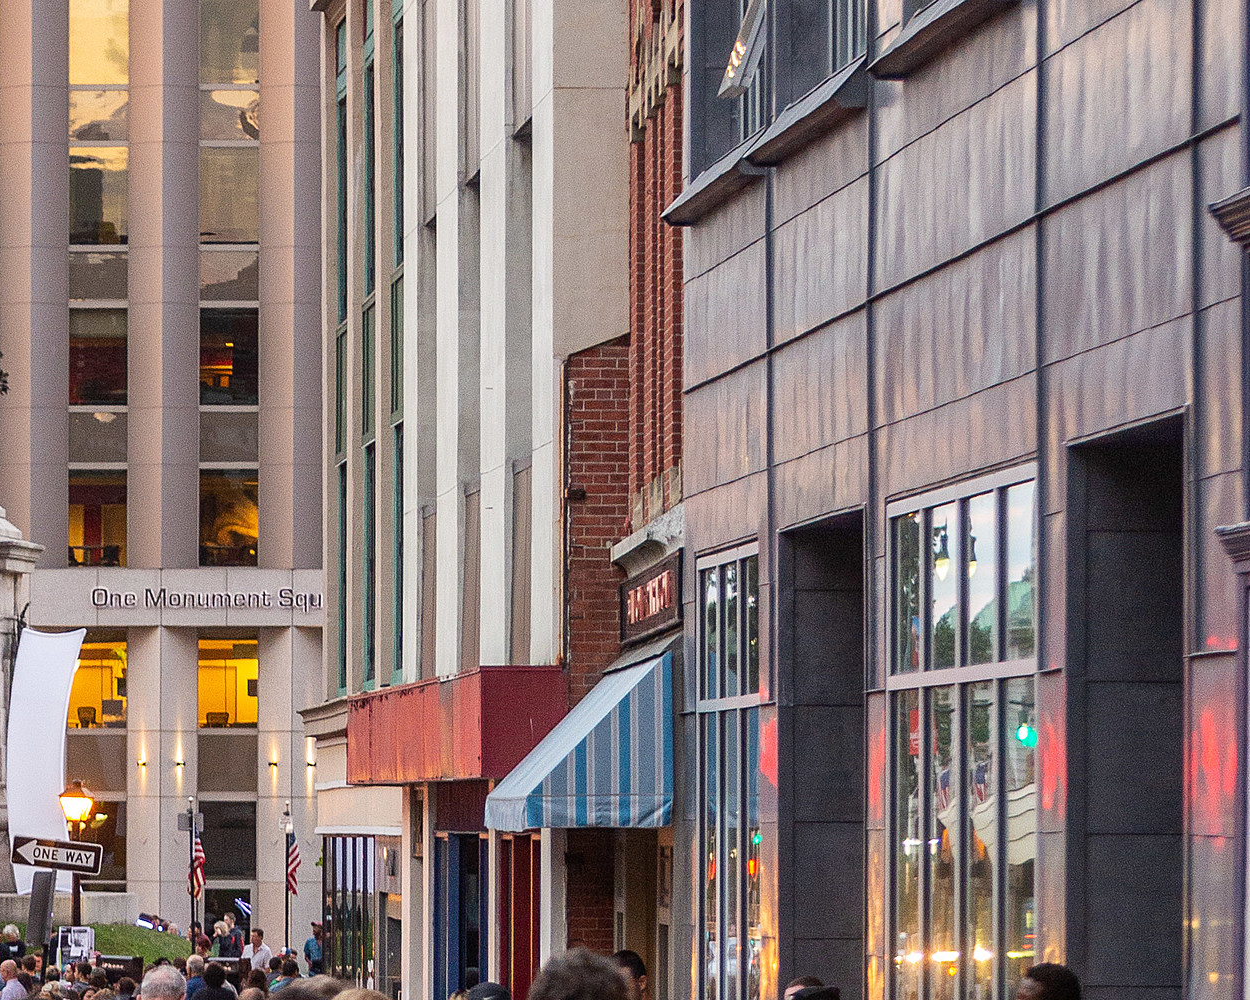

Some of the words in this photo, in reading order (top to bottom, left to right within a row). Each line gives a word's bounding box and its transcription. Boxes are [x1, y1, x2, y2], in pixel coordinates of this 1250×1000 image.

[92, 588, 136, 608] One
[145, 588, 272, 608] Monument
[33, 847, 59, 861] ONE
[66, 851, 92, 864] WAY
